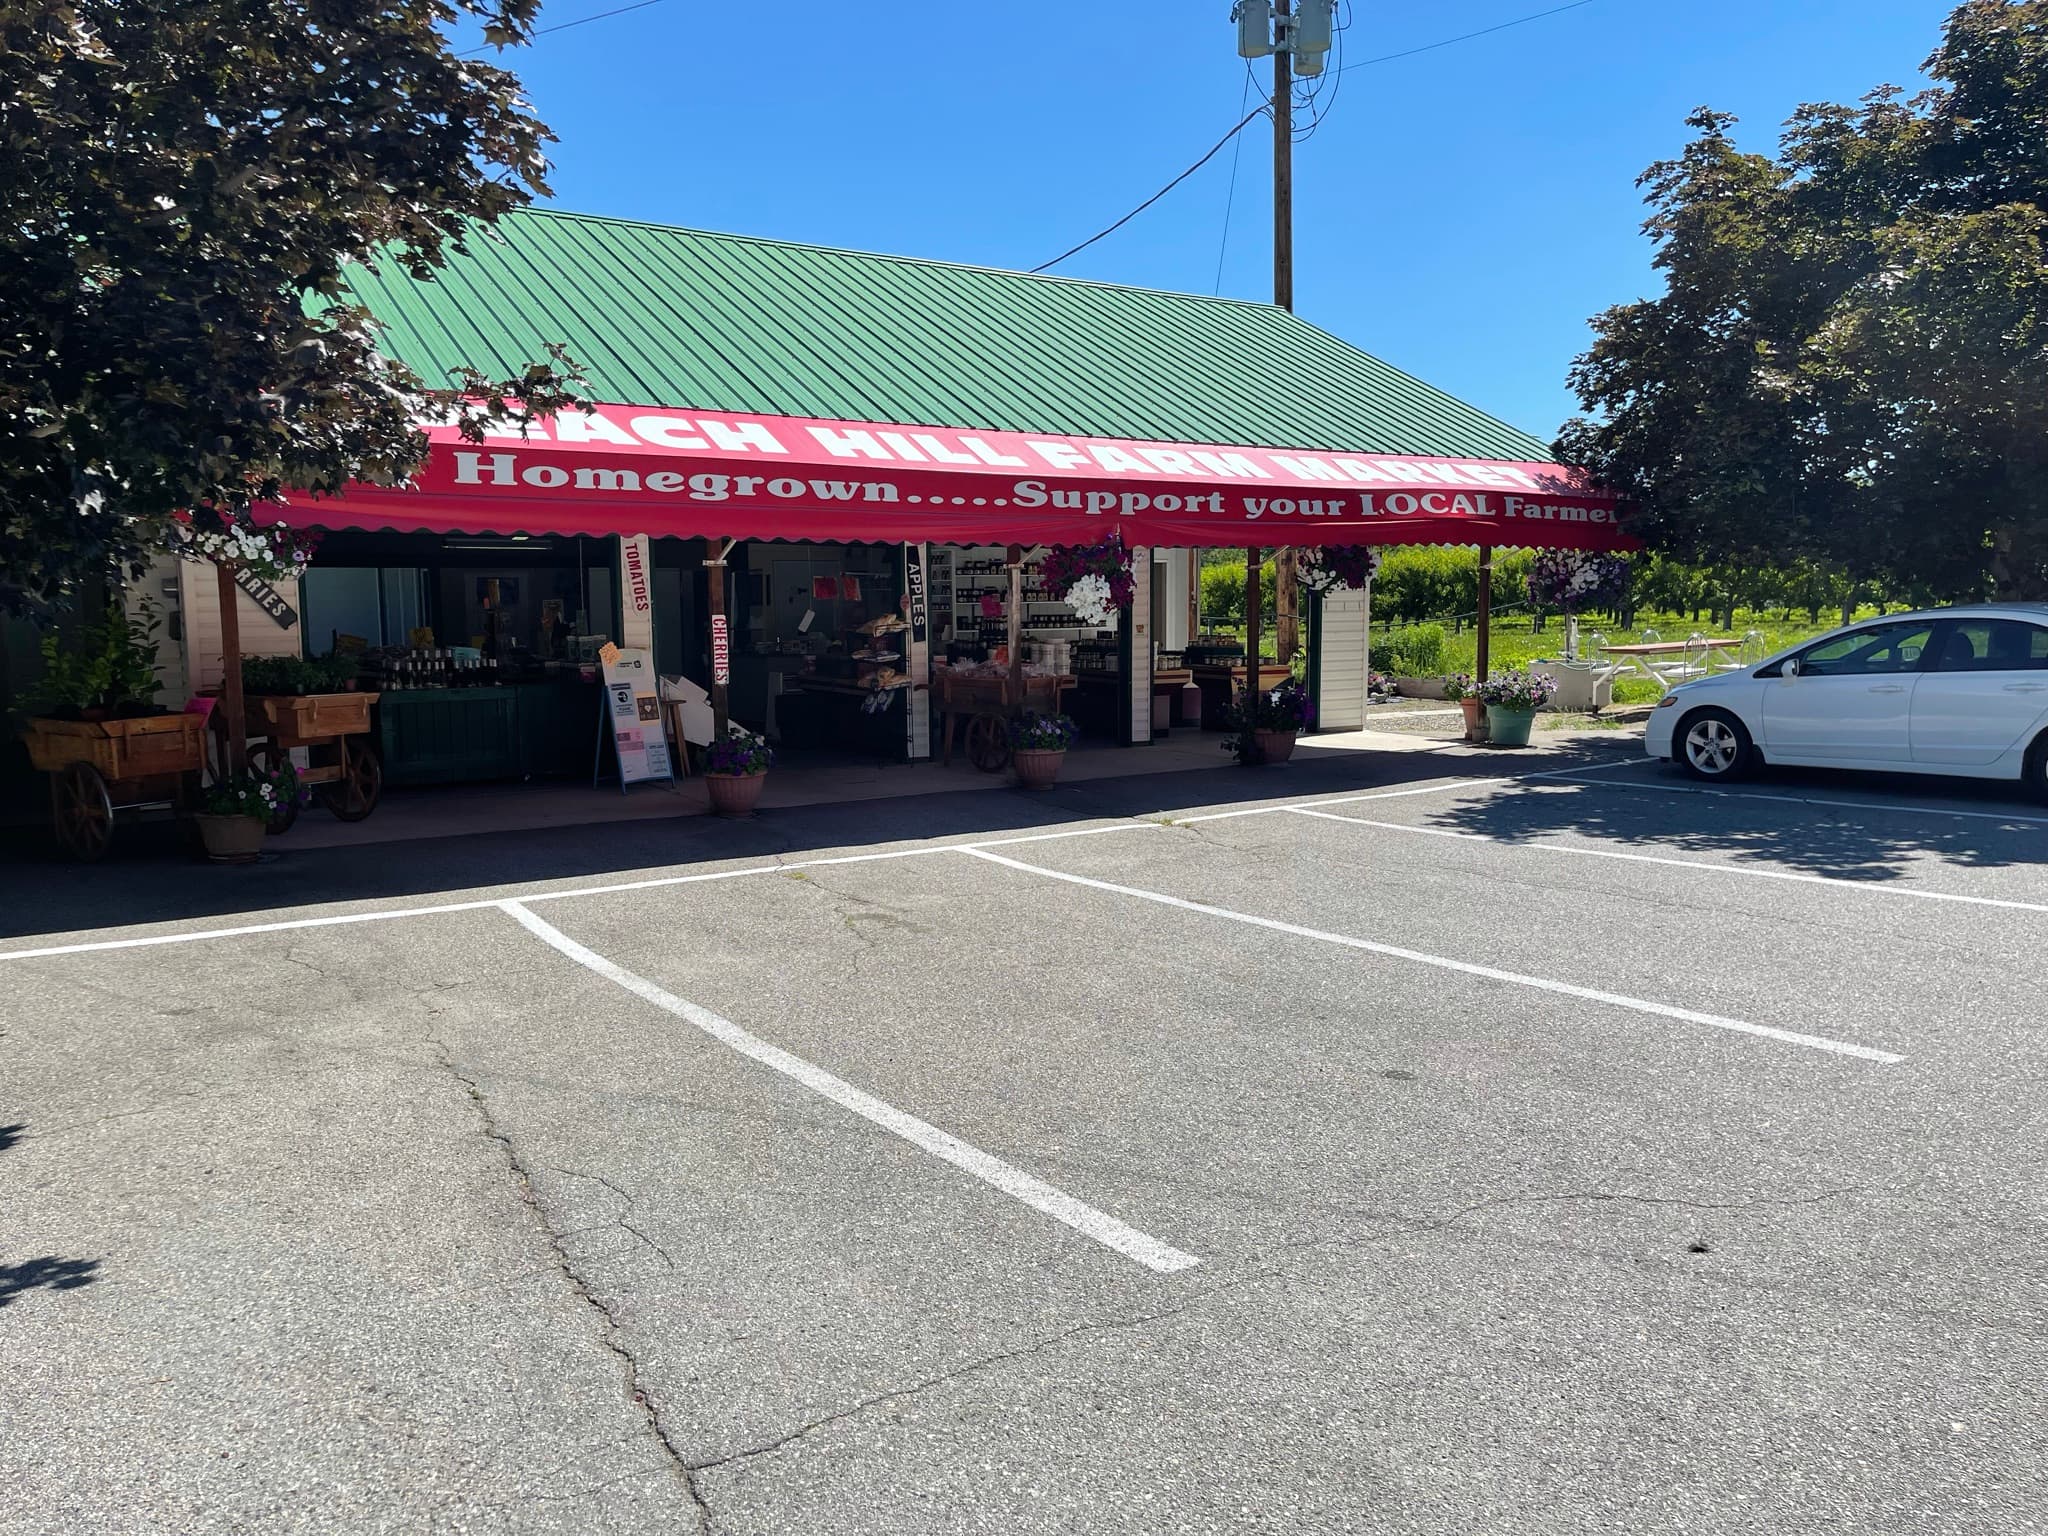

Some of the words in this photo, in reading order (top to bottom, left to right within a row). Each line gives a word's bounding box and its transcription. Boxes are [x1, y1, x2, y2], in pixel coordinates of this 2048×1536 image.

[804, 426, 1029, 468] HILL
[1024, 440, 1274, 479] FARM
[1267, 454, 1544, 489] MARKET
[1243, 497, 1346, 520] your
[1359, 492, 1496, 517] LOCAL
[234, 567, 287, 617] RRIES
[625, 543, 649, 612] TOMATOES
[908, 562, 925, 627] APPLES
[713, 618, 729, 683] CHERRIES
